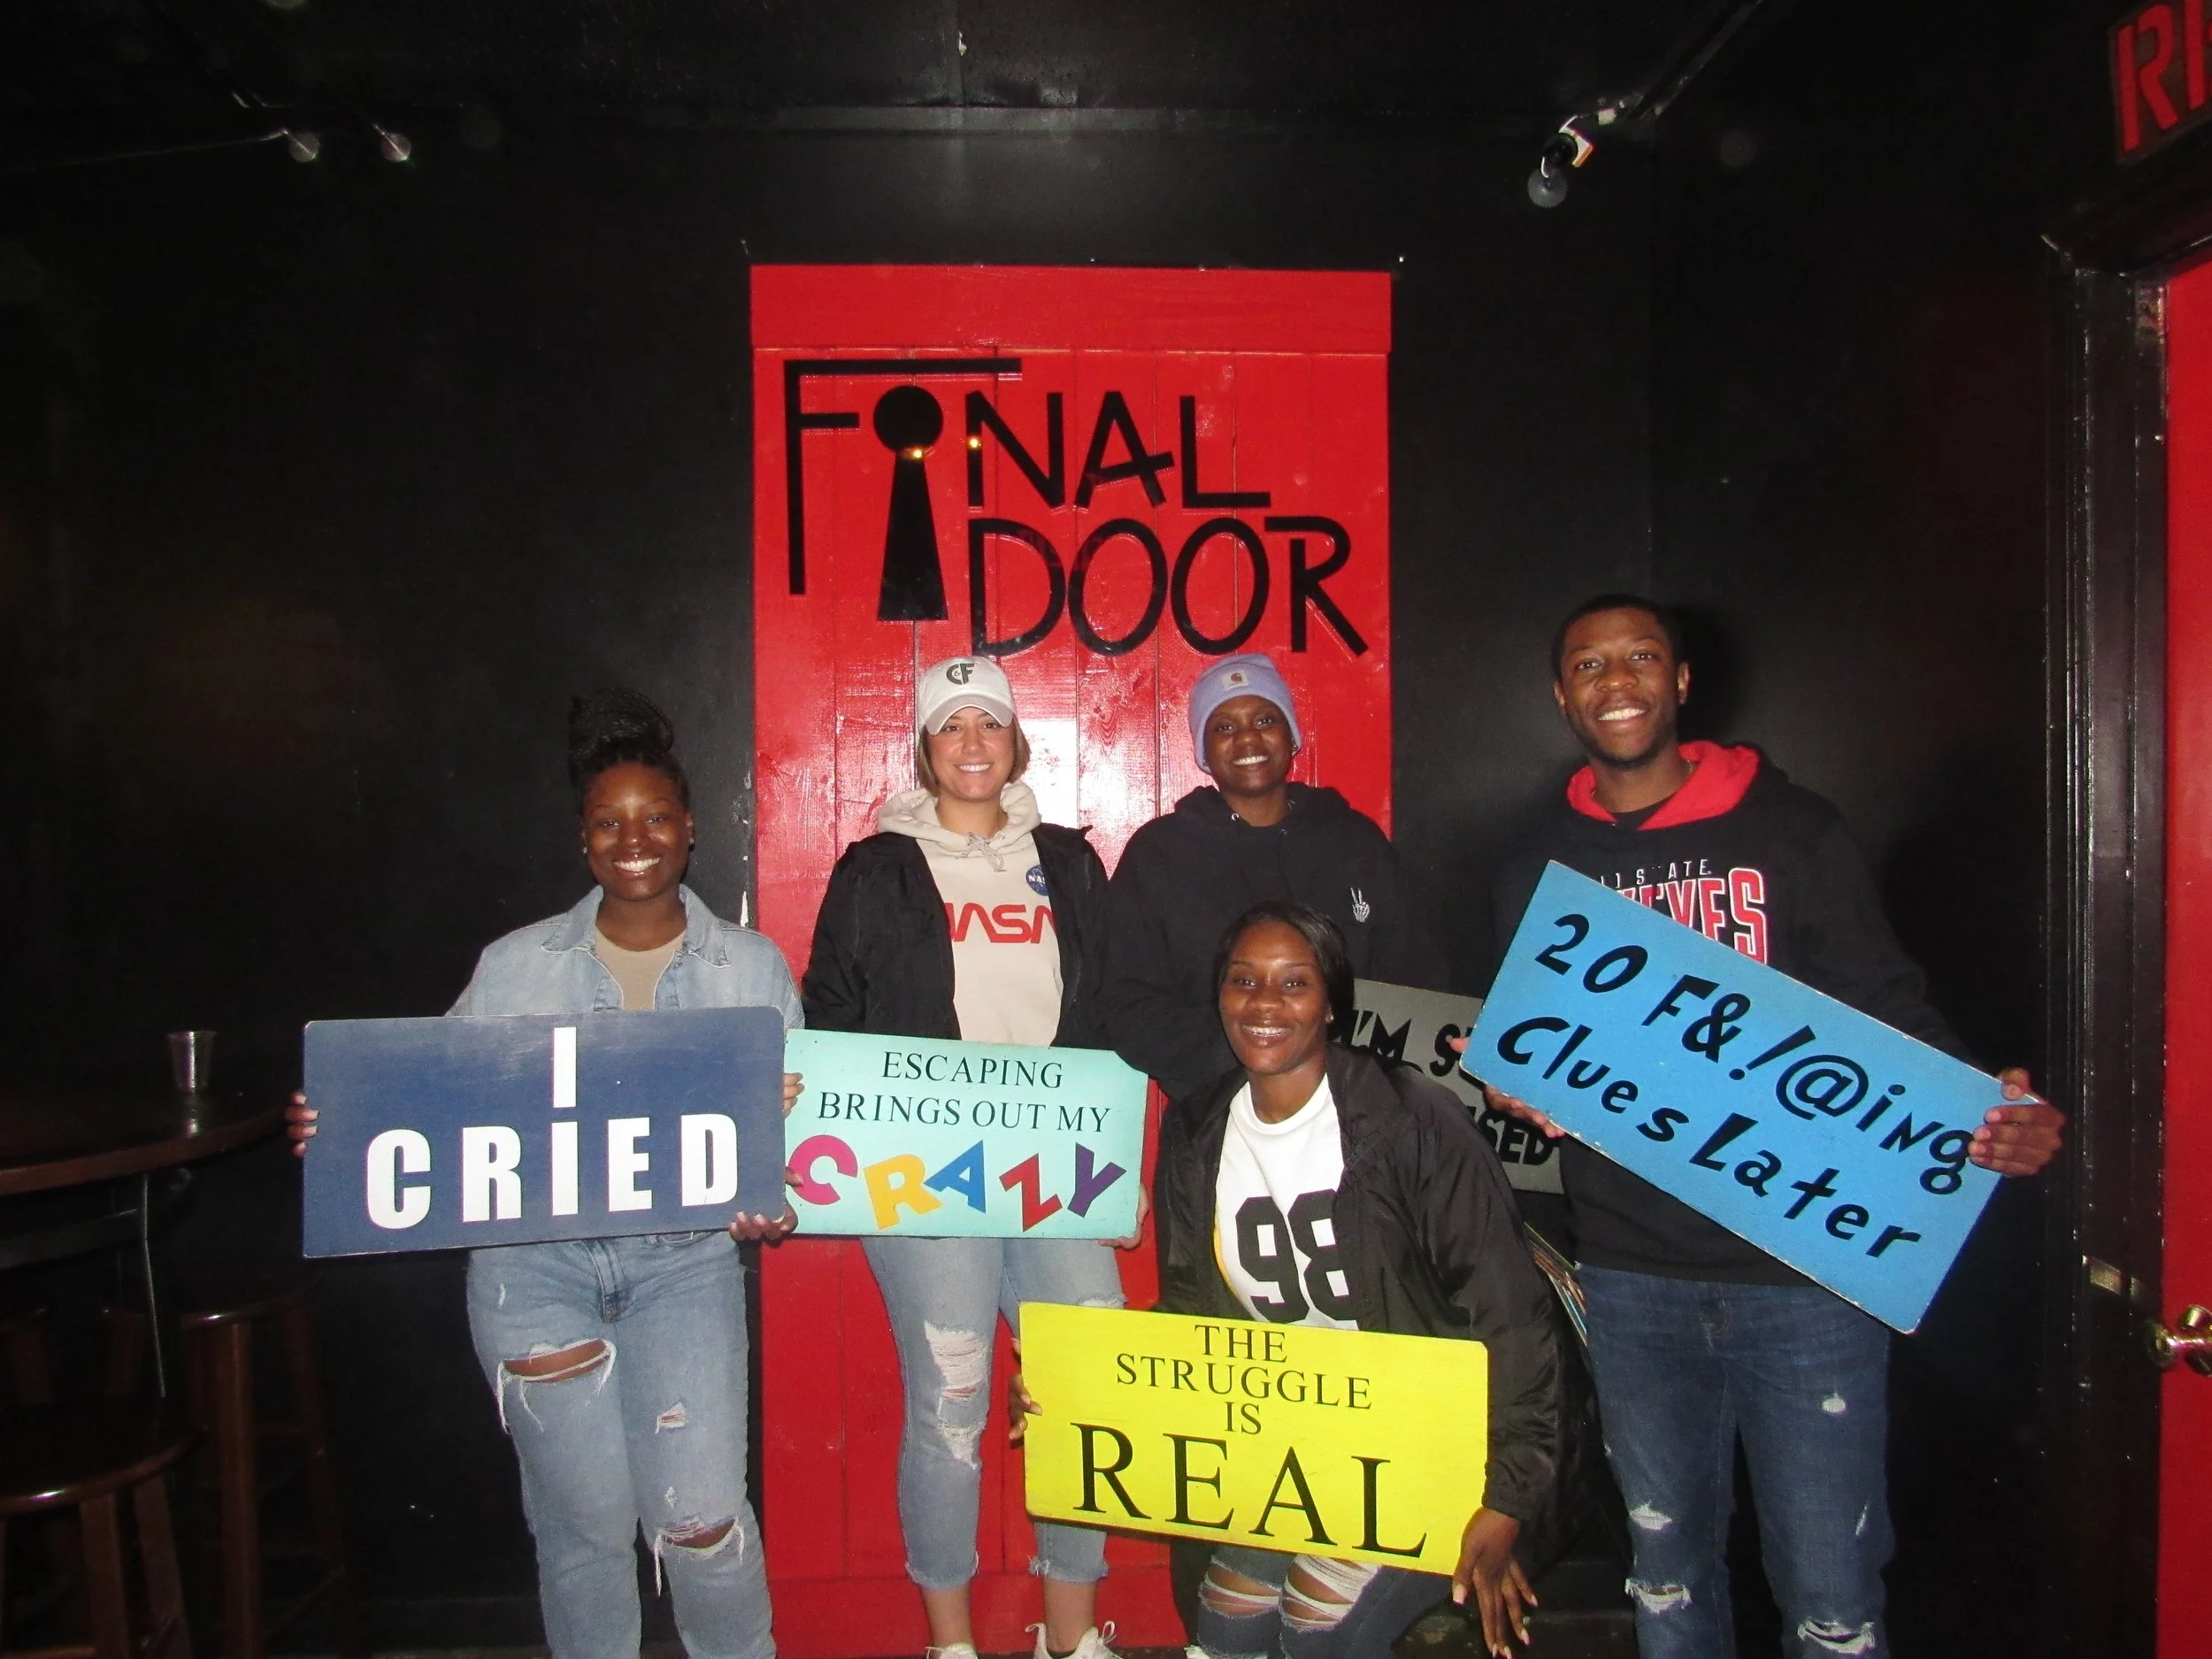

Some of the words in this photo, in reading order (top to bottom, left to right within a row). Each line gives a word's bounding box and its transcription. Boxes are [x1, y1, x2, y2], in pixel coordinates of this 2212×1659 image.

[968, 517, 1370, 657] DOOR
[1534, 913, 1648, 994] 20
[553, 1026, 577, 1108] I
[881, 1051, 1064, 1088] ESCAPING
[818, 1091, 961, 1125] BRINGS
[972, 1100, 1047, 1129] OUT
[1057, 1105, 1112, 1133] MY
[366, 1113, 739, 1229] CRIED
[787, 1134, 1127, 1233] CRAZY
[1235, 1188, 1359, 1325] 98
[1117, 1354, 1372, 1409] STRUGGLE
[1194, 1325, 1288, 1363] THE
[1225, 1402, 1262, 1435] IS
[1071, 1423, 1428, 1559] REAL
